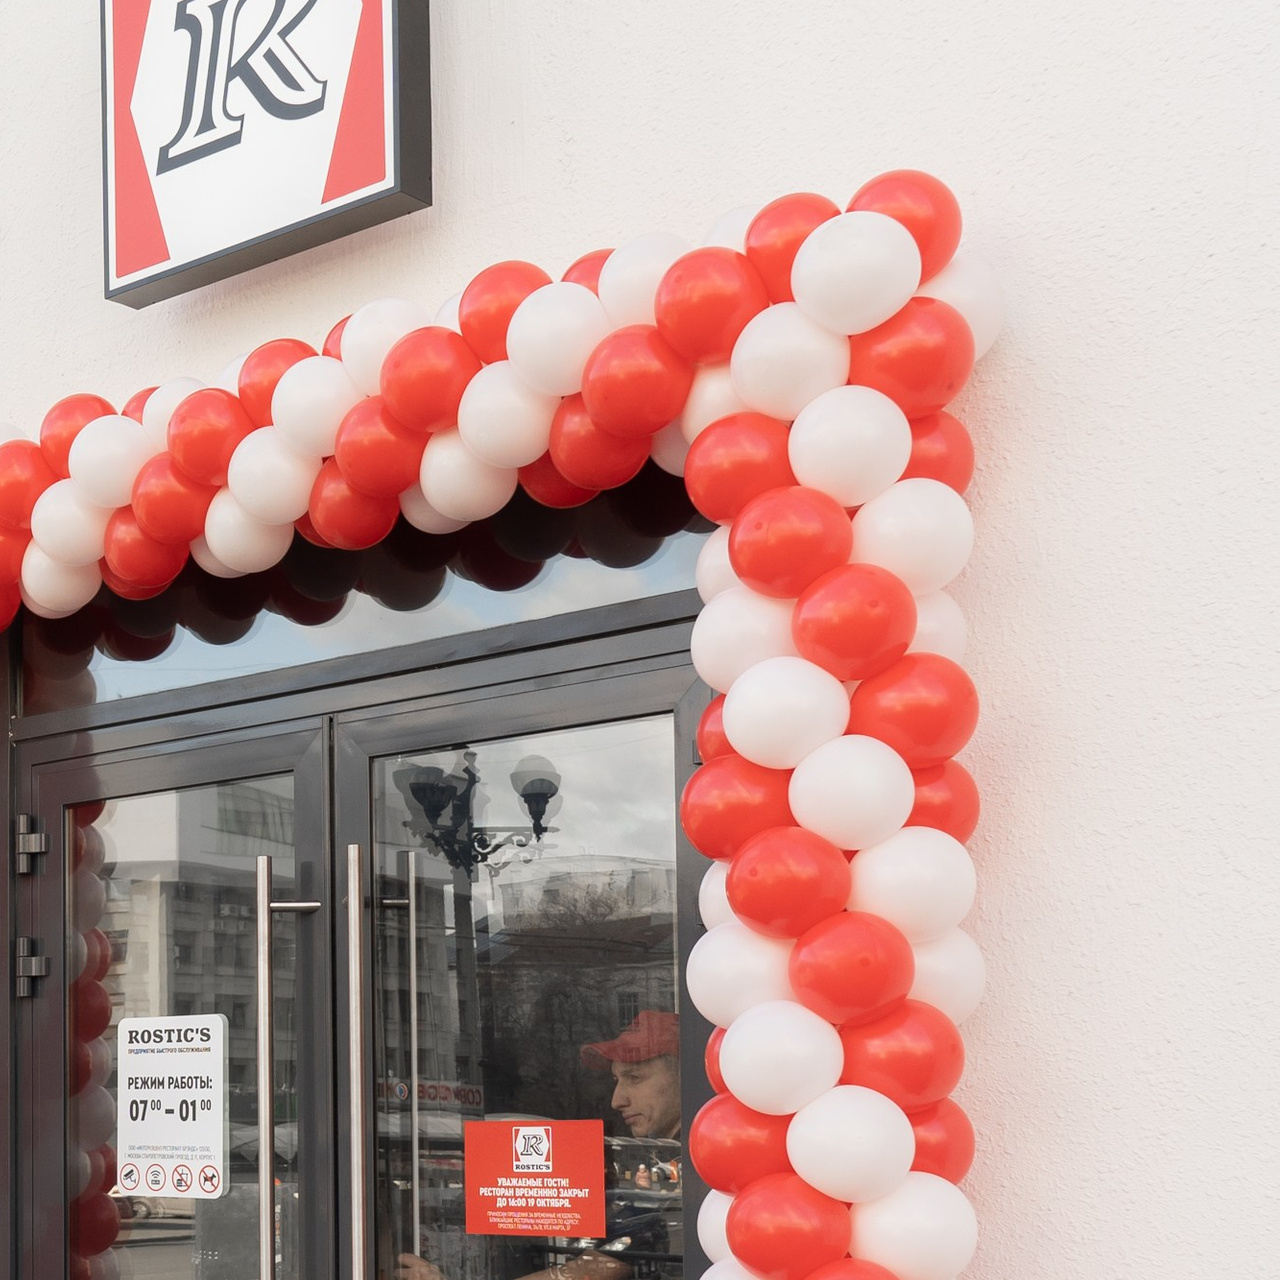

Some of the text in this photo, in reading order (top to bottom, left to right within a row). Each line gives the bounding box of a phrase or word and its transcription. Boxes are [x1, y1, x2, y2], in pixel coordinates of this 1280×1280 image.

[128, 1028, 211, 1044] ROSTIC'S
[128, 1076, 212, 1089] РЕЖИМ РАБОТЫ:
[497, 1178, 569, 1187] УВАЖАЕМЫЕ ГОСТИ!
[480, 1187, 514, 1196] РЕСТОРАН
[559, 1189, 589, 1198] ЗАКРЫТ
[497, 1198, 571, 1207] ДО 16:00 19 ОКТЯБРЯ.
